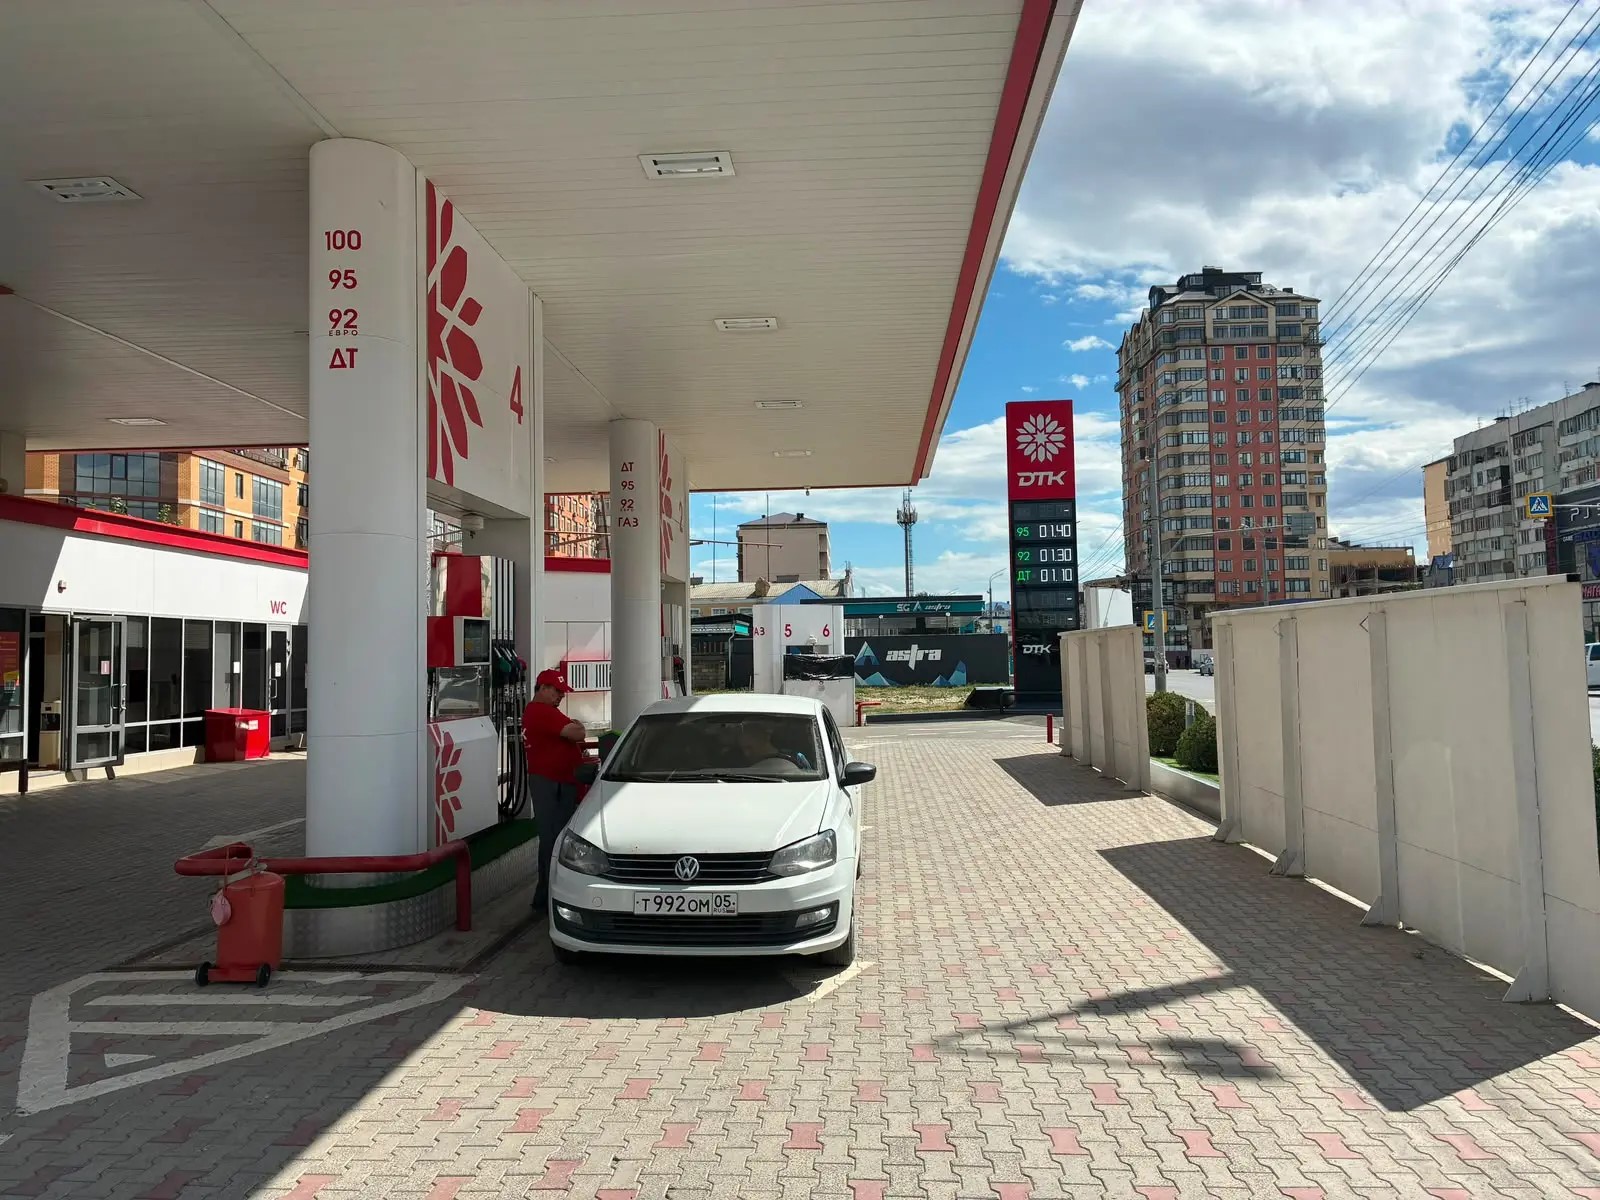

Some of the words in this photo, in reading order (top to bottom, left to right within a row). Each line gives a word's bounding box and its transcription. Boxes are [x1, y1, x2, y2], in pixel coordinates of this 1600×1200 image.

[324, 229, 362, 251] 100
[328, 269, 358, 290] 95
[328, 308, 358, 330] 92
[328, 329, 358, 337] ЕВРО
[509, 364, 524, 425] 4
[621, 481, 634, 490] 95
[1016, 470, 1068, 487] DTK
[621, 499, 634, 508] 92
[618, 517, 639, 527] ГАЗ
[1016, 526, 1030, 537] 95
[1039, 524, 1071, 538] 01.40
[1017, 551, 1031, 561] 92
[1039, 548, 1072, 562] 01.30
[1016, 570, 1032, 582] ДТ
[1040, 568, 1073, 582] 01.10
[270, 600, 287, 615] WC
[896, 603, 911, 612] SG
[753, 626, 766, 636] АЗ
[784, 623, 792, 638] 5
[822, 623, 830, 638] 6
[1022, 644, 1052, 655] DTK
[885, 644, 942, 671] astra
[714, 895, 732, 908] 05
